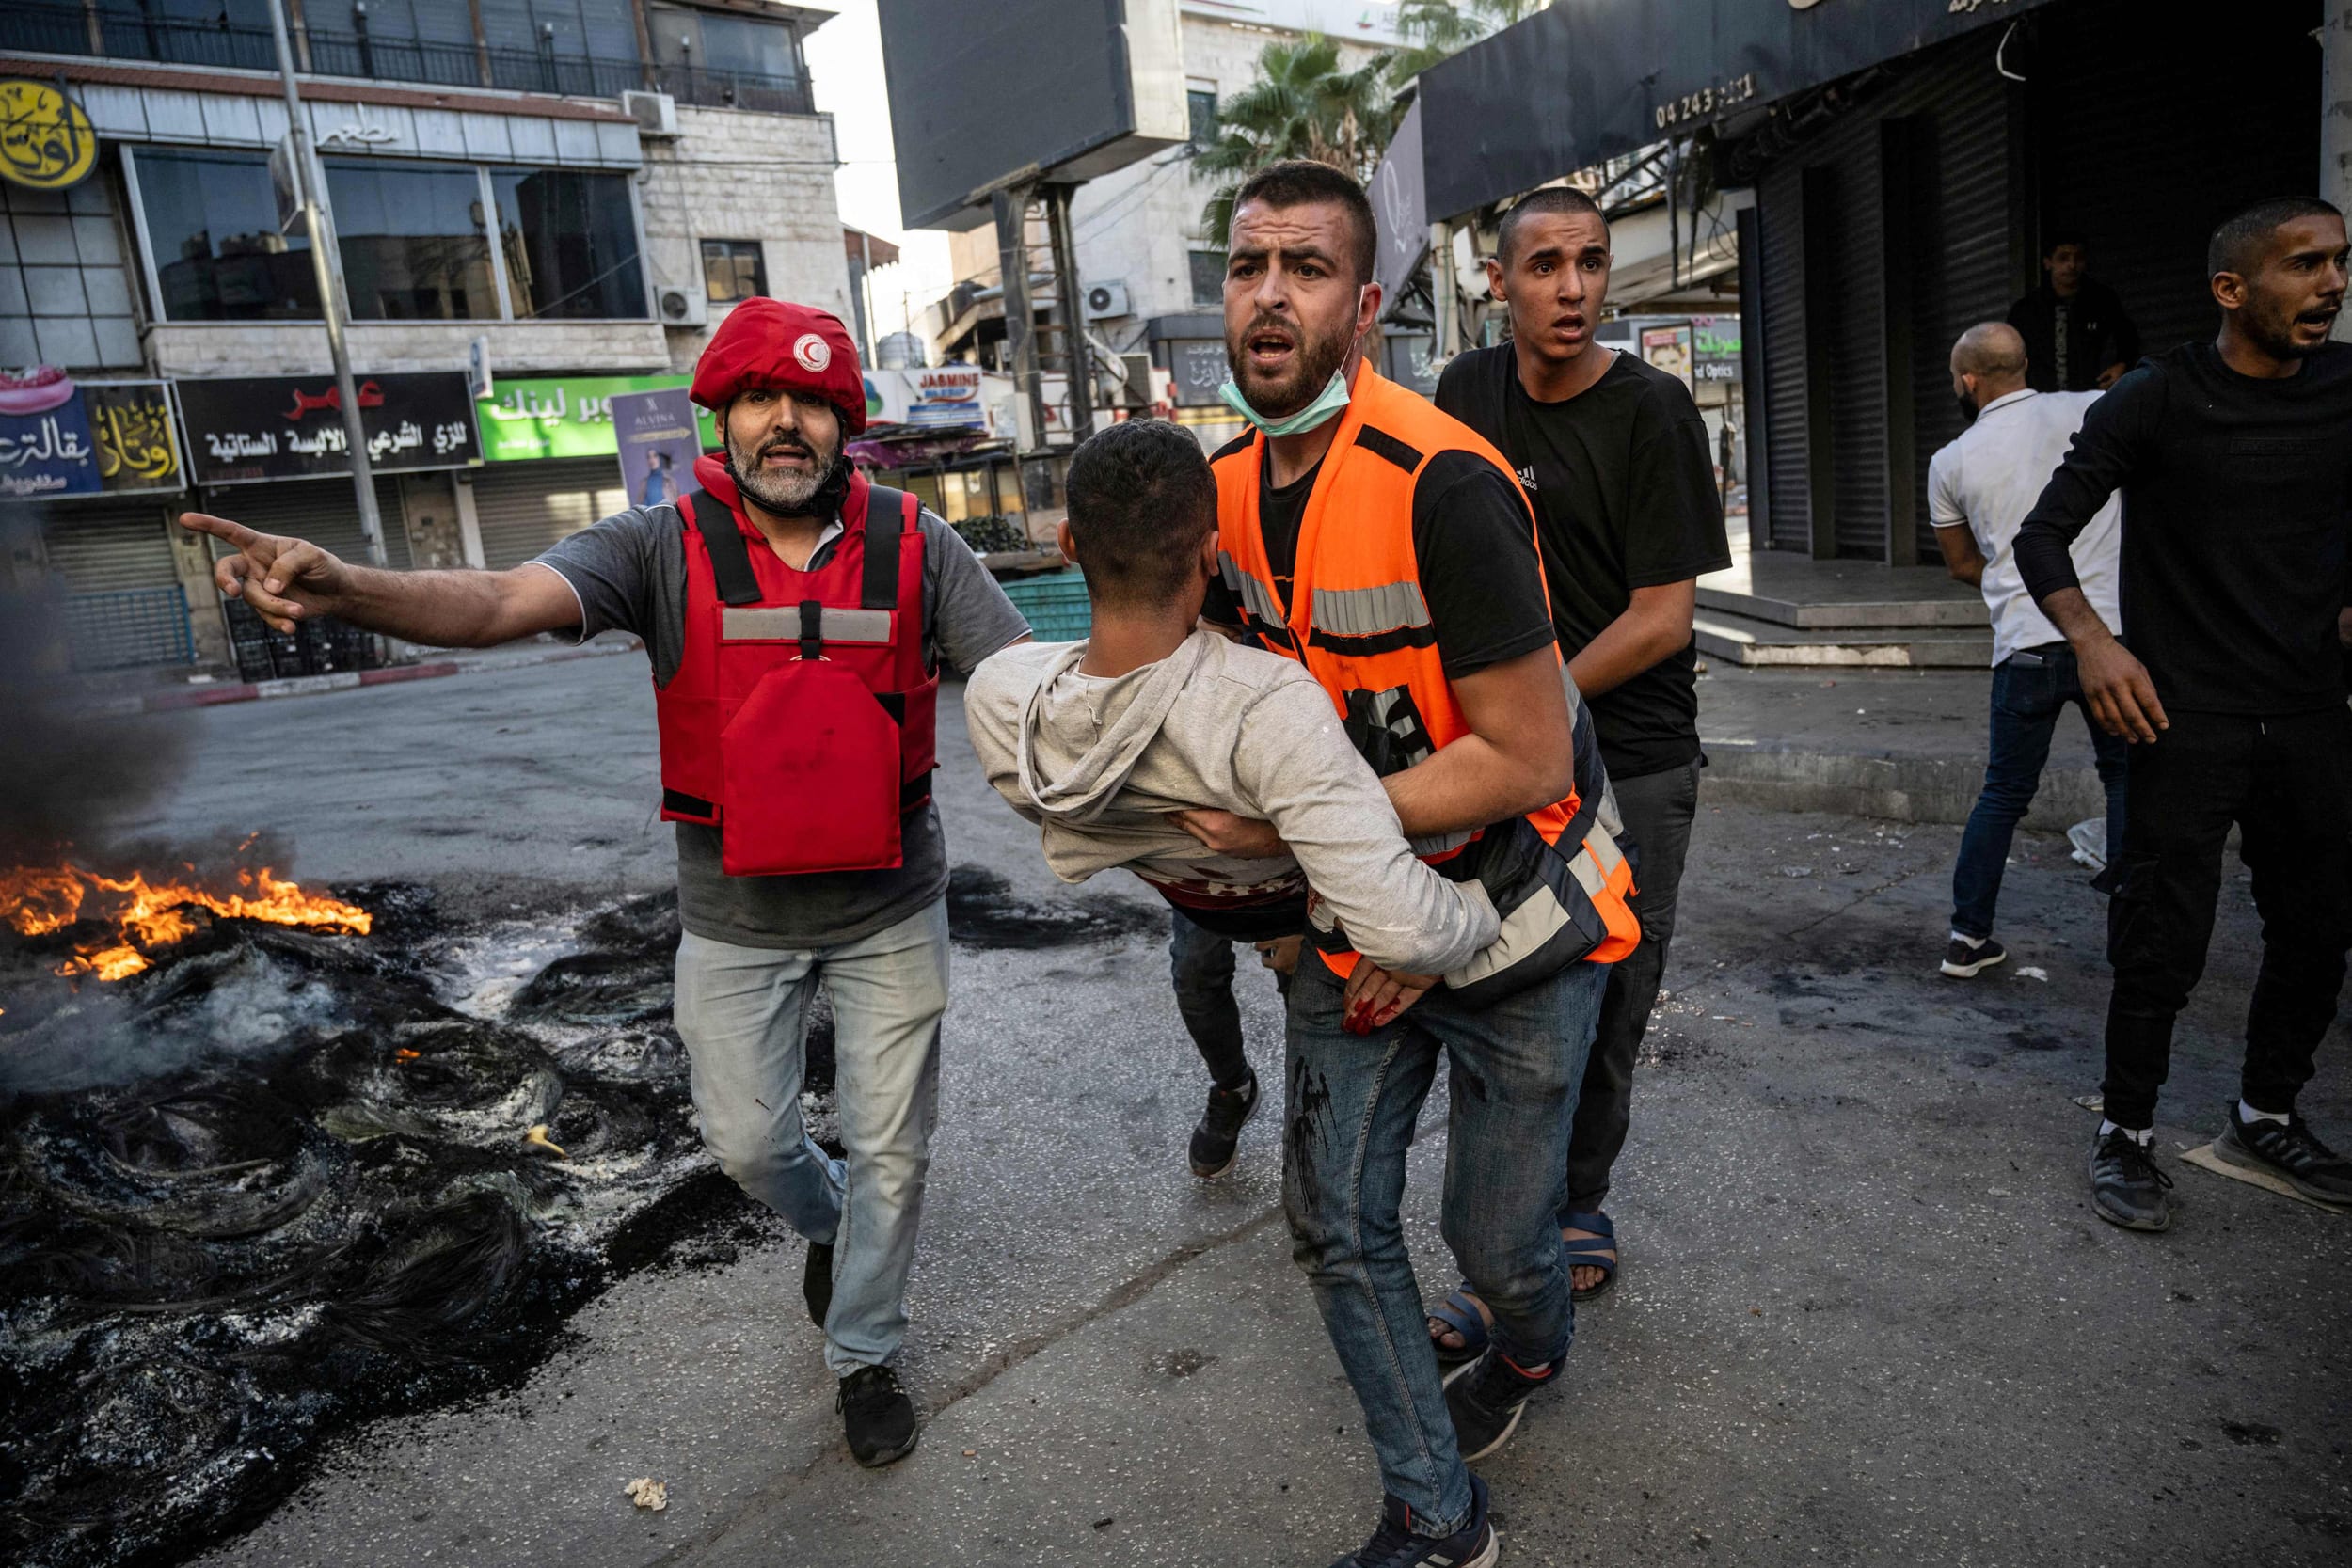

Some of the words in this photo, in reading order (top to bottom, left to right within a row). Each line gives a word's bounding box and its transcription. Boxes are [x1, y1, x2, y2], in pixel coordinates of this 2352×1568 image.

[1656, 103, 1677, 128] 04
[919, 372, 979, 388] JASMINE
[1706, 362, 1733, 381] Optics
[283, 380, 385, 421] عمر
[489, 387, 568, 428] لينك
[634, 413, 676, 426] ALVINA
[367, 420, 423, 462] الشرعي
[1518, 475, 1539, 491] didas
